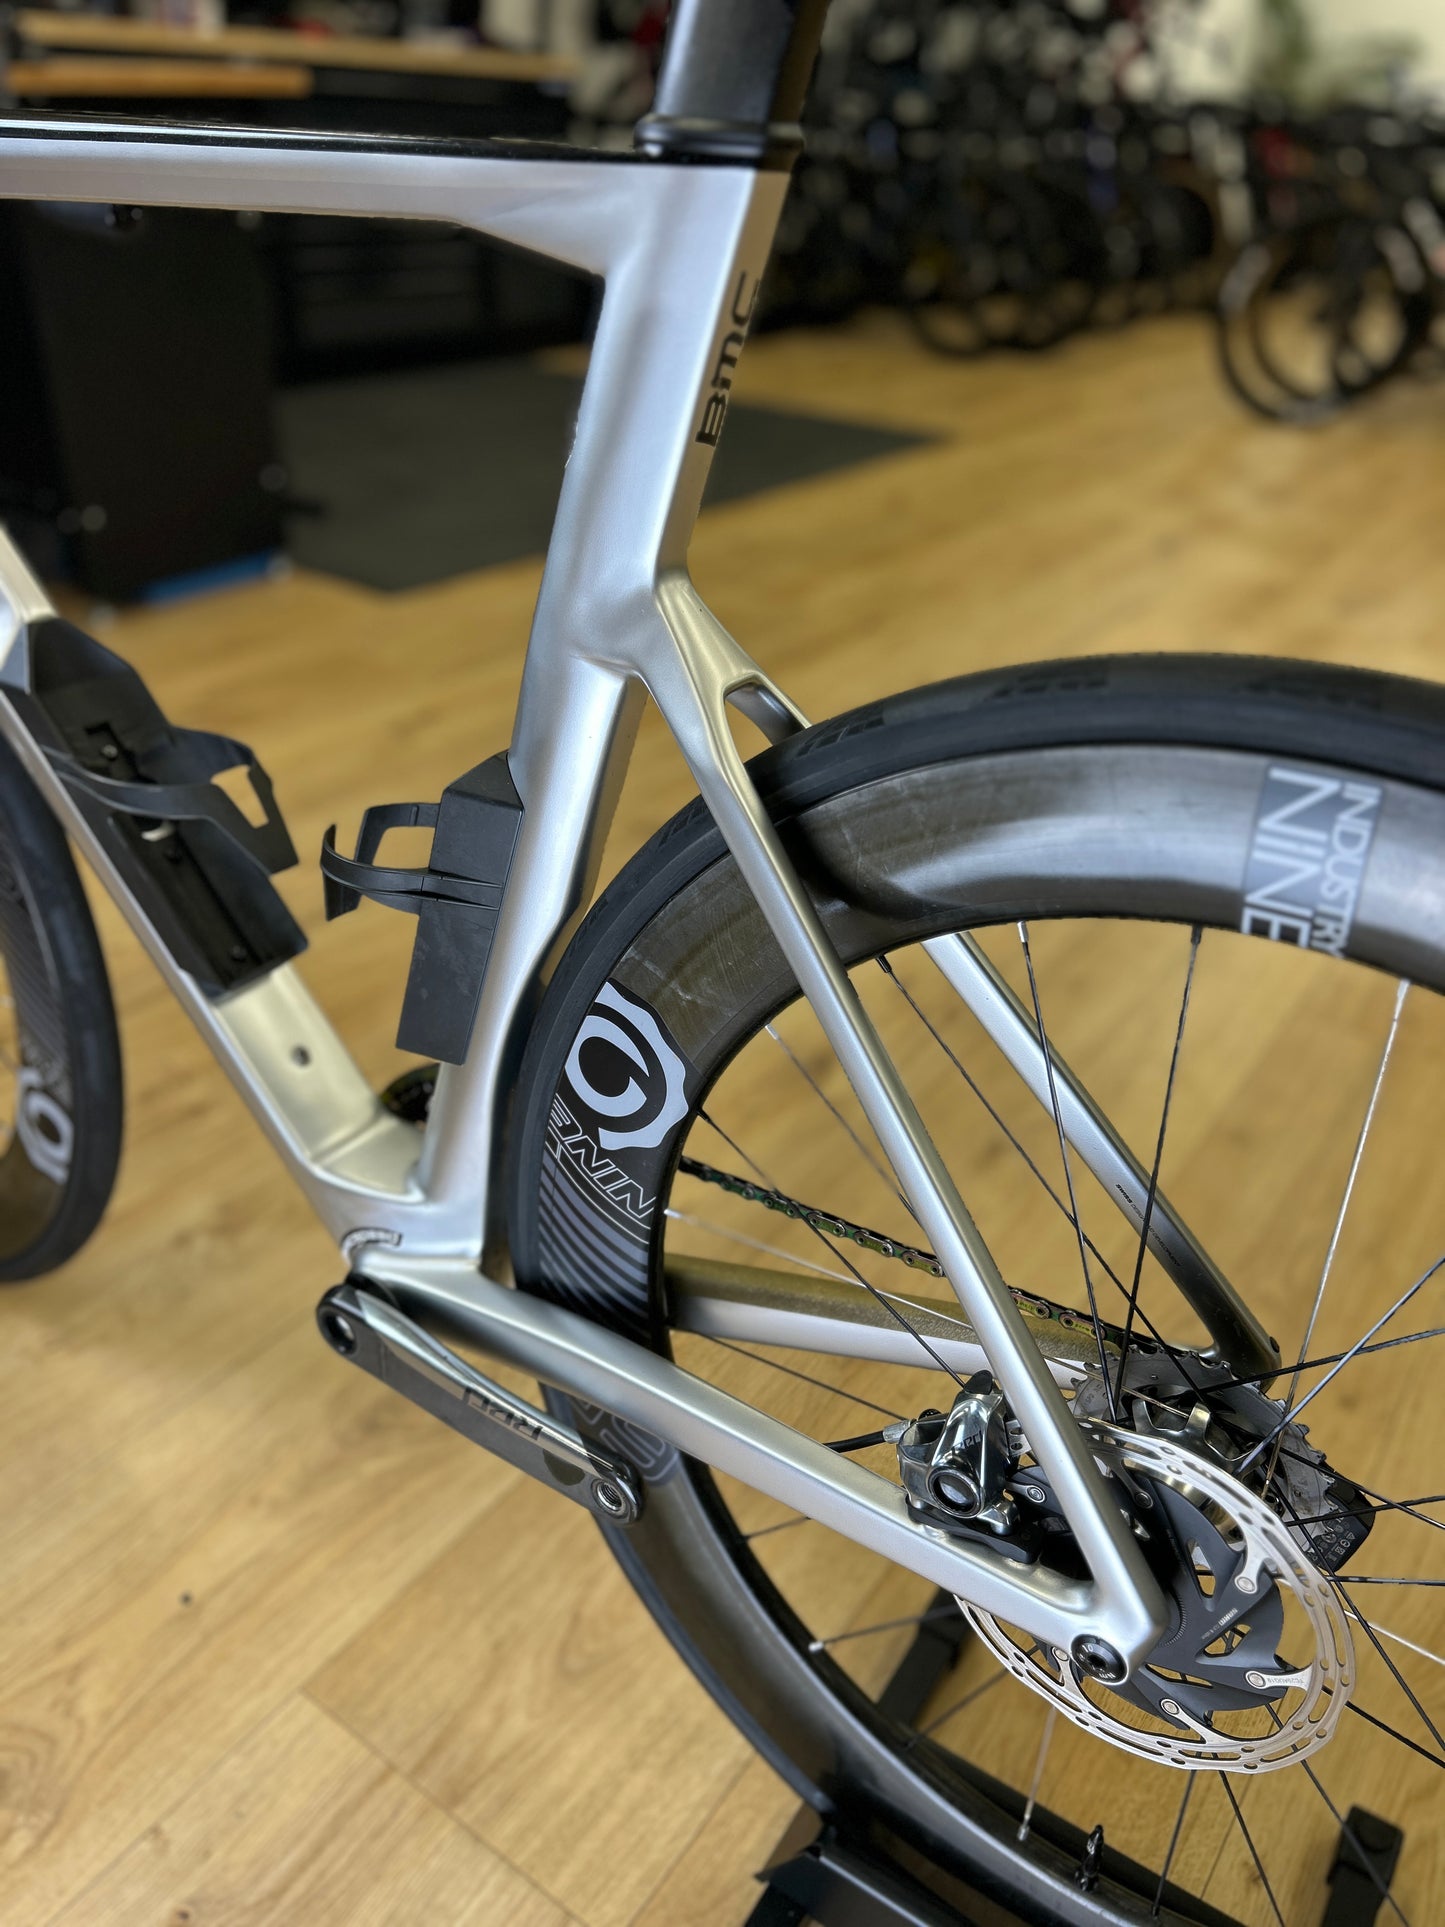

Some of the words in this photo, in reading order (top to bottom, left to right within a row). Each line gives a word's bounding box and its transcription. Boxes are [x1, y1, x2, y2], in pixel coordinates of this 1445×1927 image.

[695, 271, 760, 446] BMC
[1241, 767, 1342, 948] NINE
[1309, 782, 1382, 958] INDUSTRY
[549, 1092, 657, 1219] NINE
[1115, 1183, 1133, 1204] SWISS
